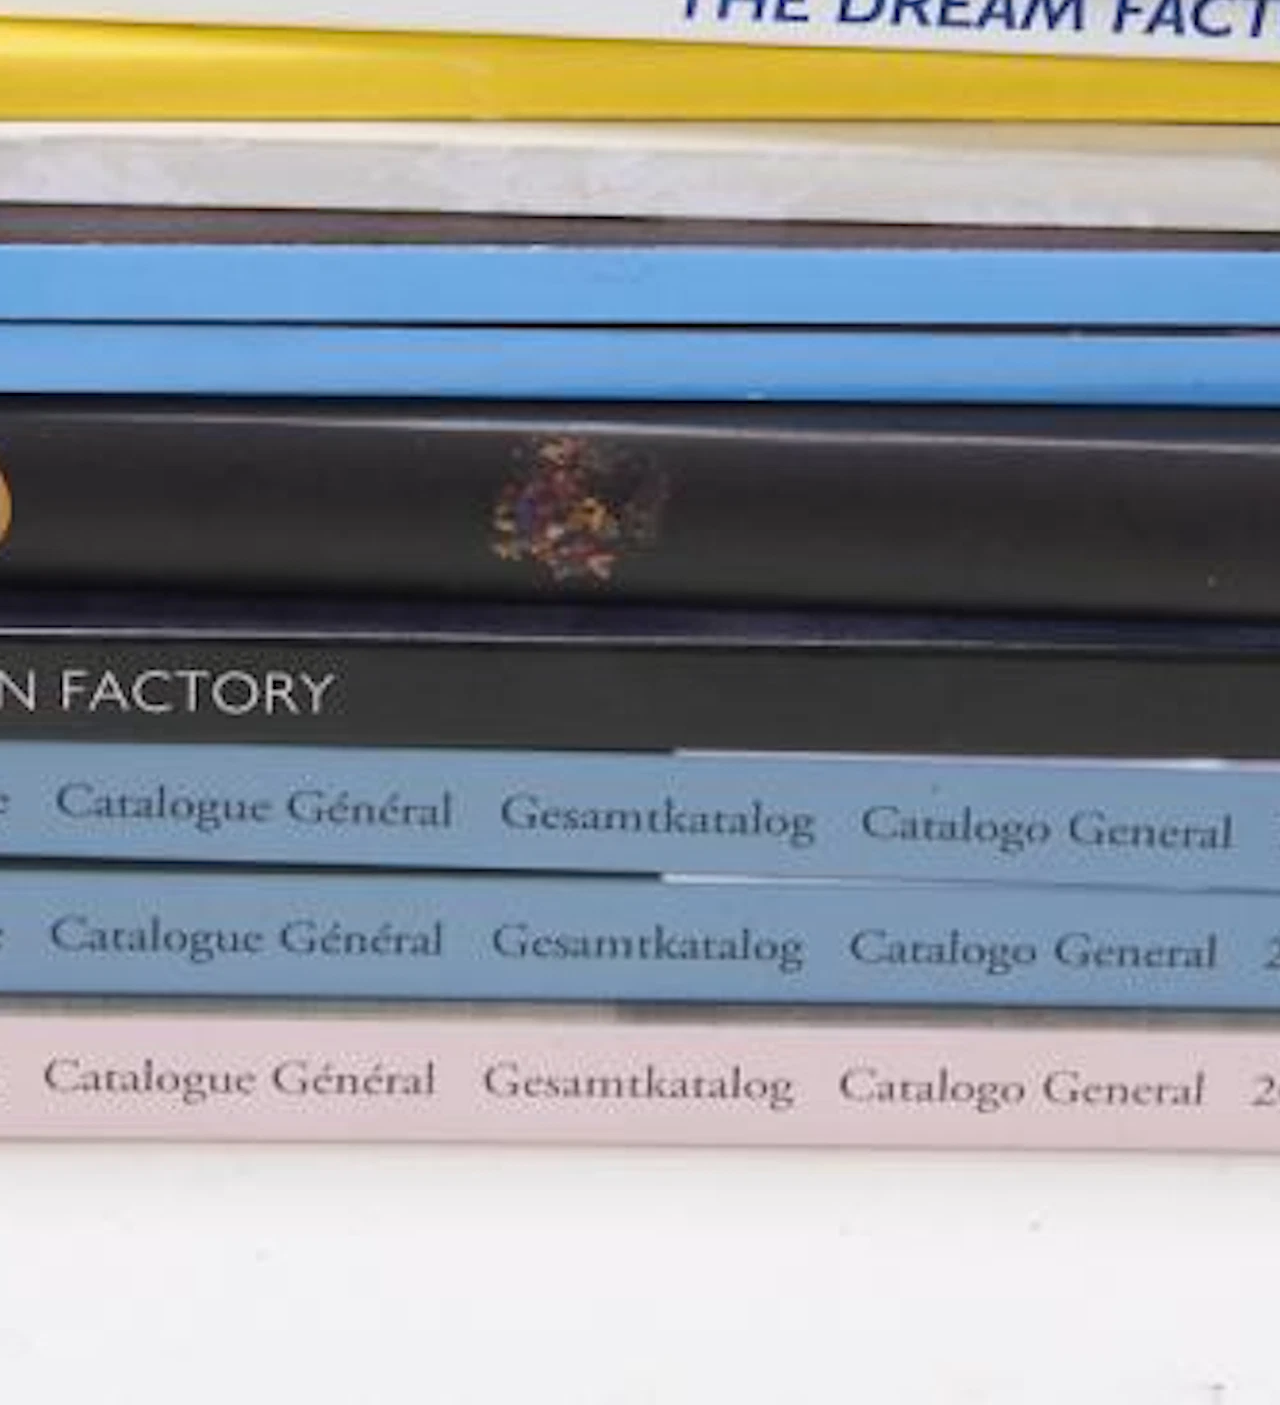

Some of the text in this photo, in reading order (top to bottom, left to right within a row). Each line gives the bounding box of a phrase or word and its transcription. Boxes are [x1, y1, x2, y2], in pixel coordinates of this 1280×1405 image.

[60, 668, 337, 716] FACTORY
[55, 778, 273, 829] Catalogue
[287, 783, 453, 830] Général
[499, 791, 816, 846] Gesamtkatalog
[861, 803, 1051, 853] Catalogo
[1067, 810, 1234, 853] General
[49, 913, 266, 963] Catalogue
[278, 915, 444, 960] Général
[491, 920, 805, 973] Gesamtkatalog
[849, 927, 1038, 975] Catalogo
[1053, 930, 1219, 971] General
[43, 1055, 259, 1103] Catalogue
[271, 1057, 436, 1100] Général
[482, 1060, 795, 1111] Gesamtkatalog
[839, 1065, 1025, 1113] Catalogo
[1042, 1068, 1206, 1109] General
